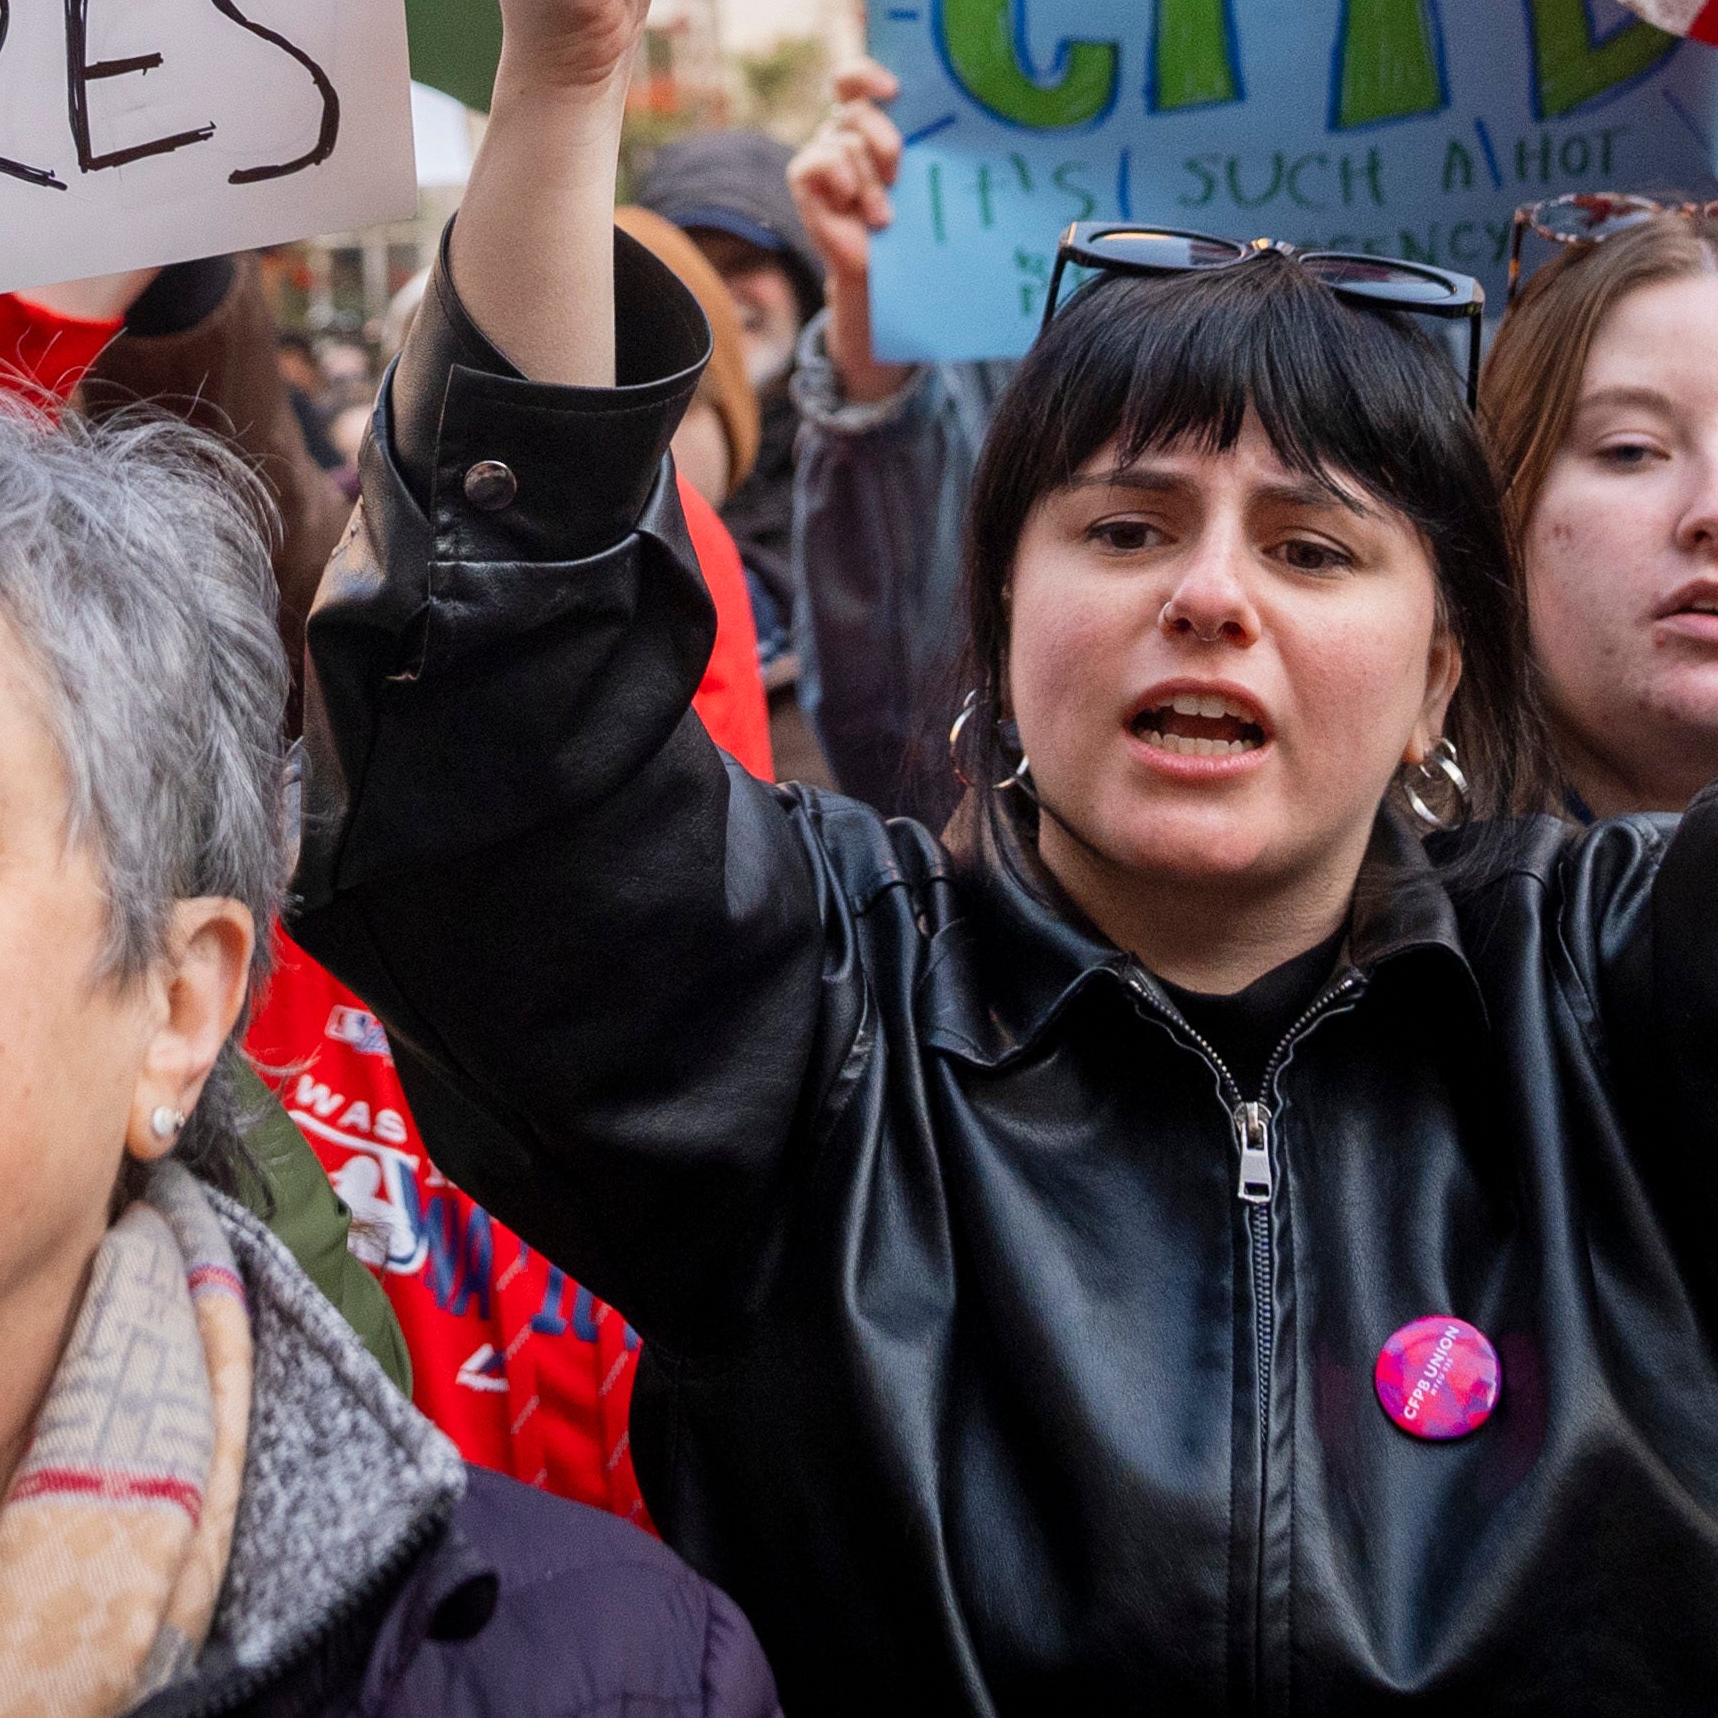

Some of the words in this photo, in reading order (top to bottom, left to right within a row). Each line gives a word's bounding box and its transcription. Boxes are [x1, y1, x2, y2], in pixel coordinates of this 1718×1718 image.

[1178, 144, 1386, 210] SUCH
[1513, 124, 1628, 185] HOT
[1403, 1379, 1431, 1420] CFPB
[1423, 1325, 1460, 1378] UNION
